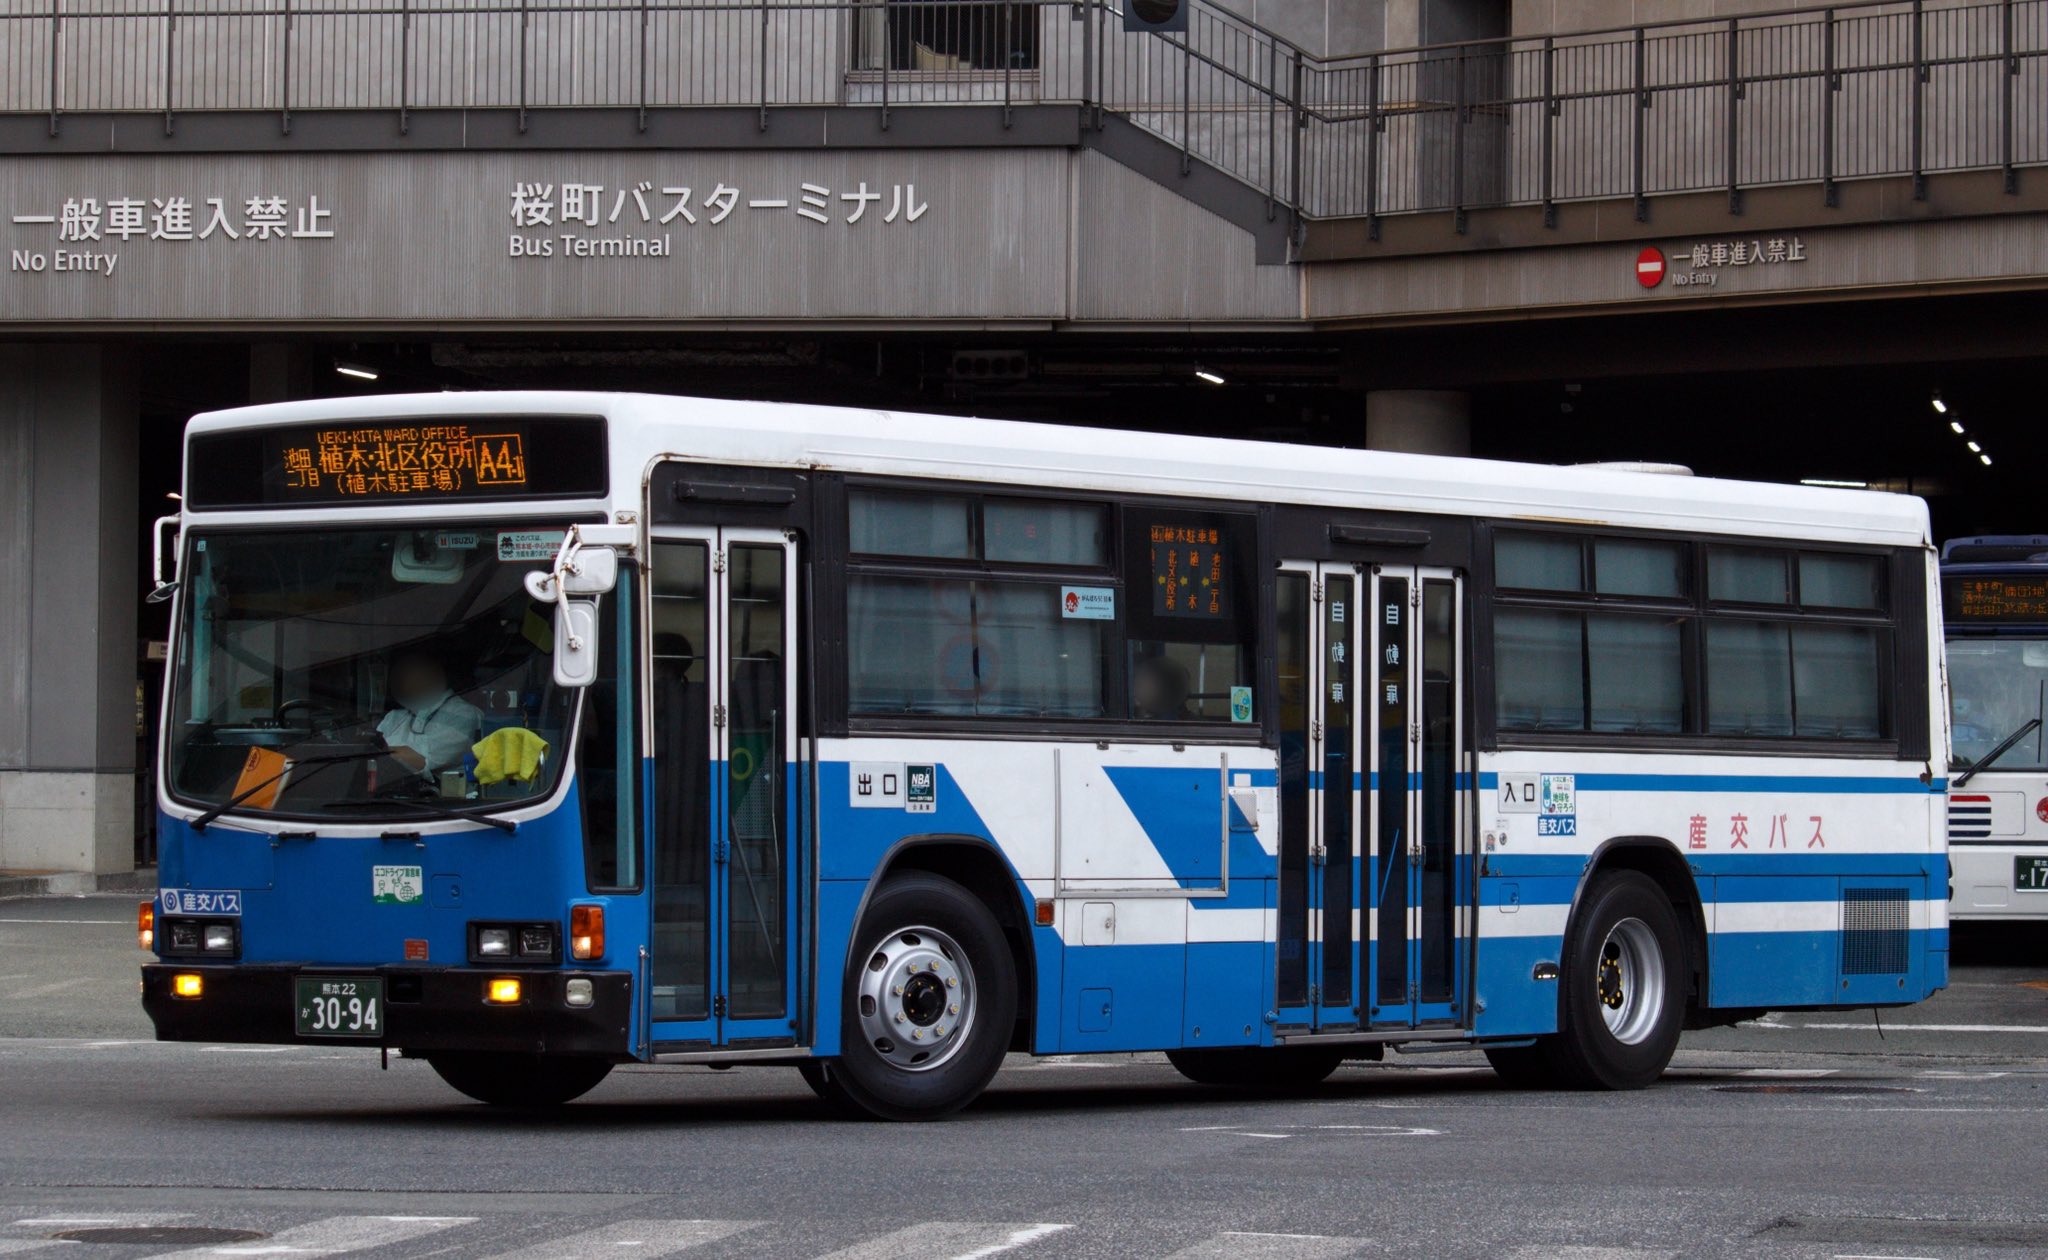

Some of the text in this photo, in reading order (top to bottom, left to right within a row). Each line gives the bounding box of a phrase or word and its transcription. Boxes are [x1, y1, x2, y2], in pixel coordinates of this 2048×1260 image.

[510, 181, 928, 227] 桜町バスターミナル
[13, 195, 334, 241] 一般車進入禁止
[509, 233, 671, 257] Bus Terminal
[1672, 237, 1806, 267] 一般車進入禁止
[12, 249, 118, 276] No Entry
[1672, 271, 1718, 287] No Entry
[384, 427, 419, 441] WARD
[421, 426, 468, 441] OFFICE
[318, 438, 474, 474] 植木・北区役所
[451, 536, 474, 545] ISUZU
[858, 773, 897, 795] 出口
[911, 773, 930, 786] NBA
[1504, 782, 1535, 803] 入口
[1539, 818, 1576, 835] 産交バス
[1689, 812, 1825, 849] 産交バス
[183, 893, 240, 911] 産交バス
[312, 997, 377, 1030] 30-94
